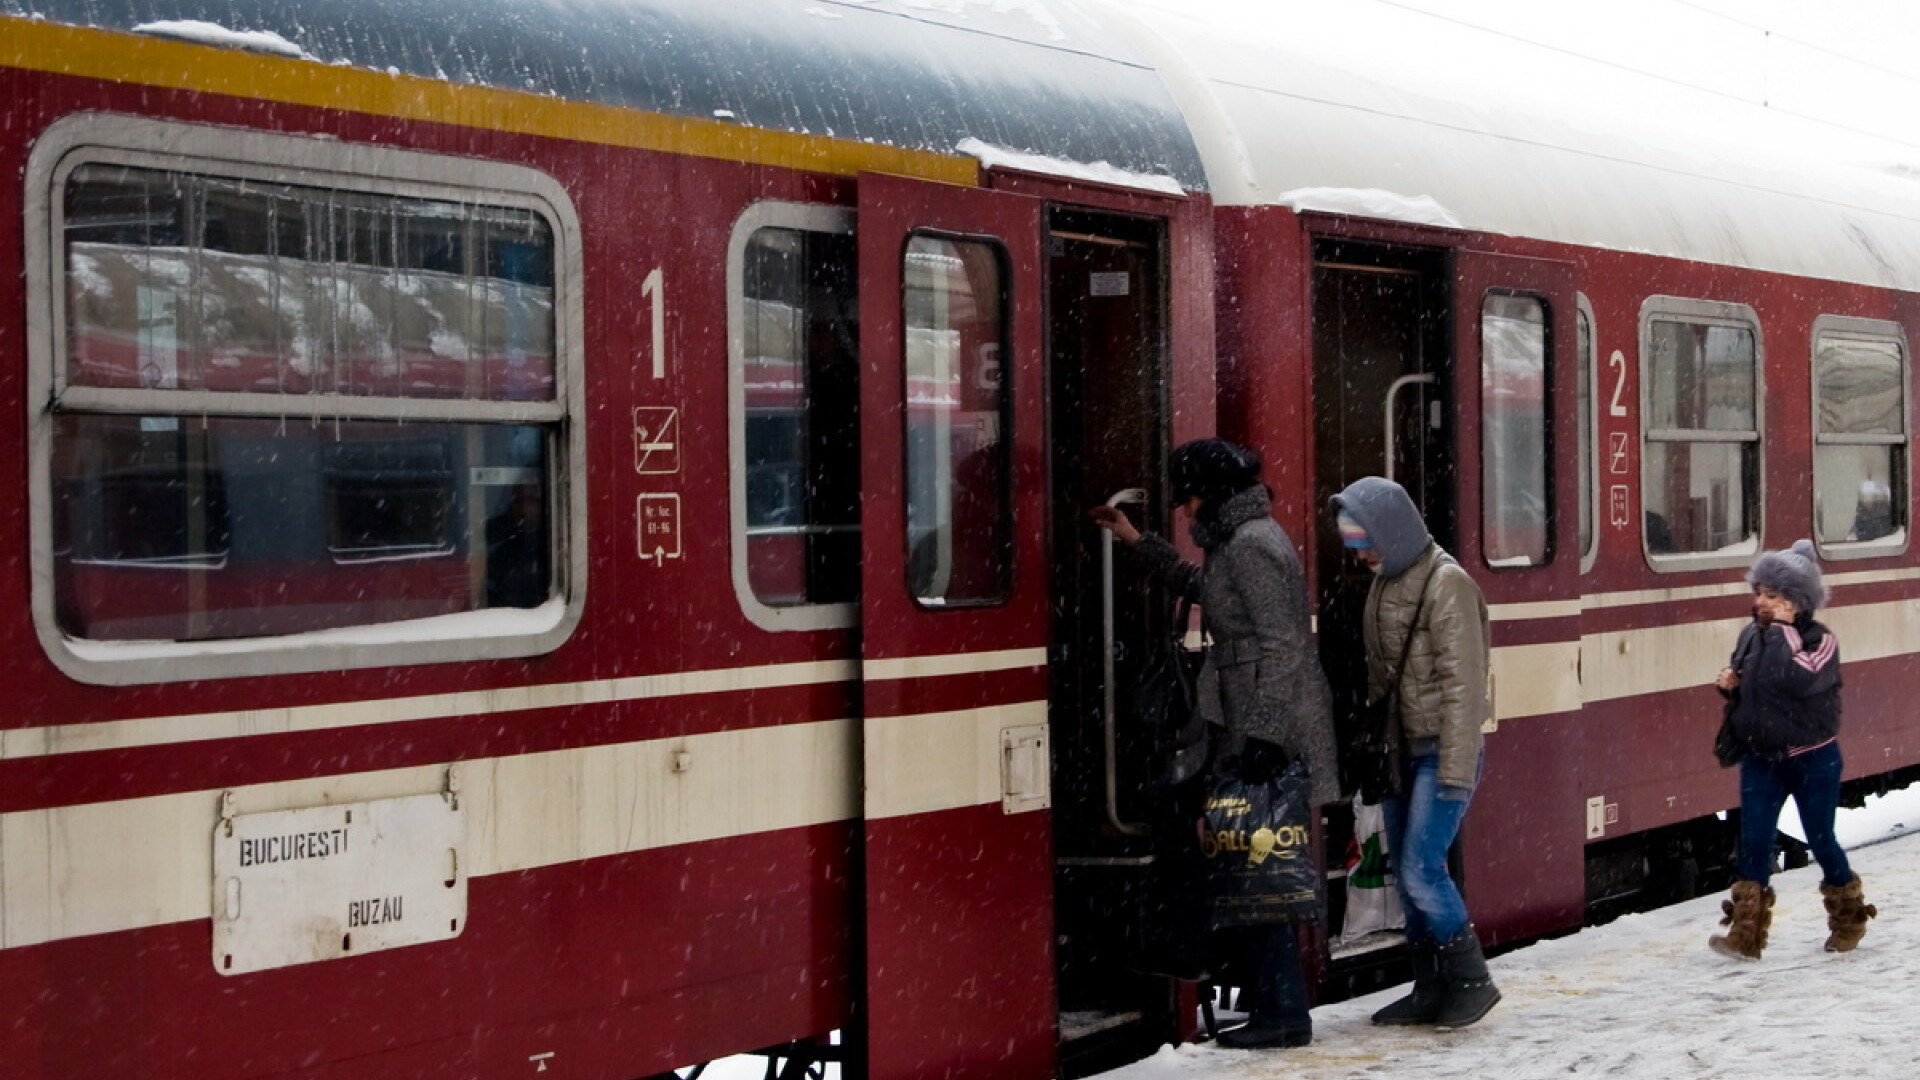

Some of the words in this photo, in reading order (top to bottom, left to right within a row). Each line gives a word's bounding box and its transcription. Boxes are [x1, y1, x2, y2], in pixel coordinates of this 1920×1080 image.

[641, 265, 665, 379] 1
[1609, 349, 1627, 416] 2
[349, 895, 403, 927] BUZAU
